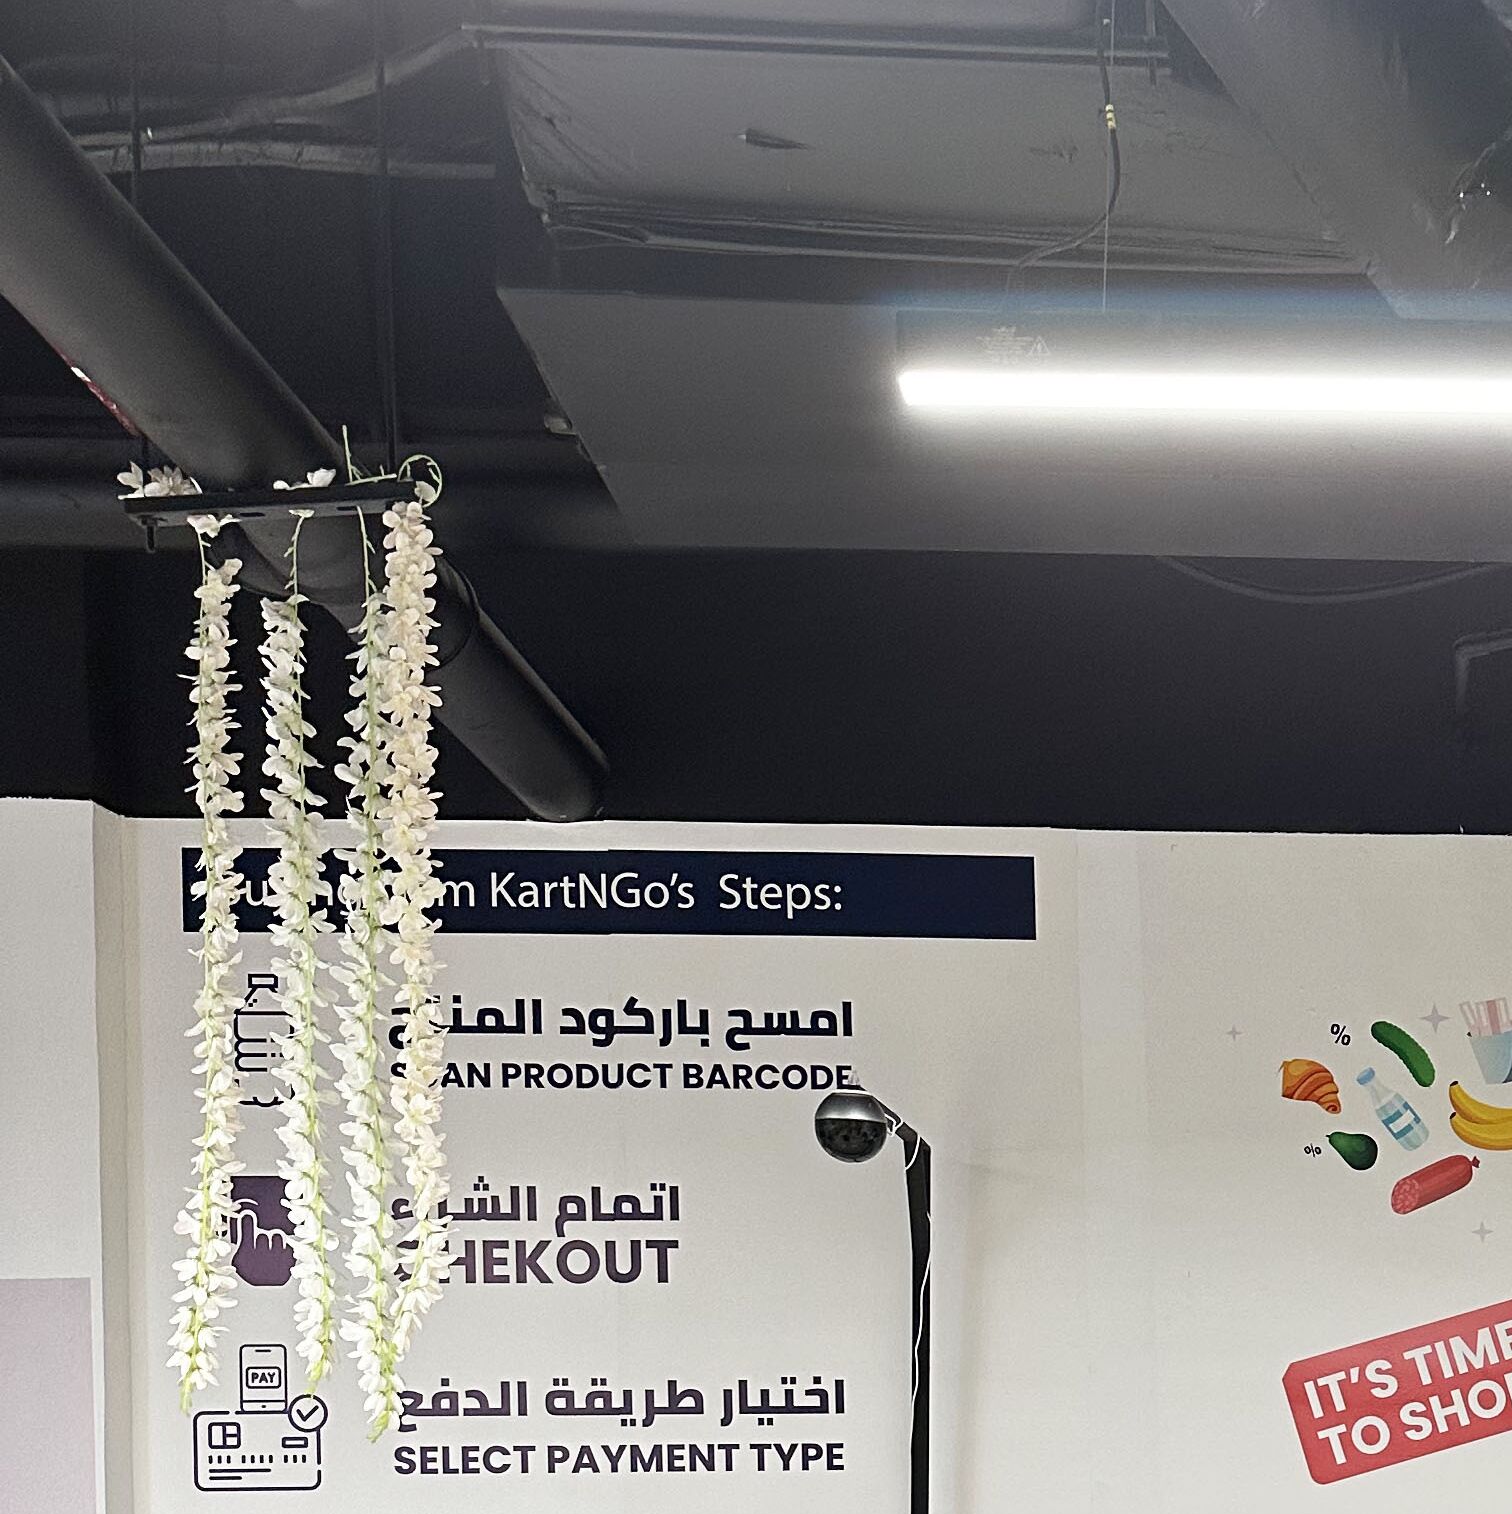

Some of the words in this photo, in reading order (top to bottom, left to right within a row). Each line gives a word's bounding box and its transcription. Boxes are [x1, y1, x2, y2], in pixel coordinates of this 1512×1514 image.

[490, 871, 697, 912] KartNGo's
[719, 875, 844, 919] Steps:
[558, 995, 711, 1049] باركود
[725, 1000, 854, 1052] امسح
[390, 1062, 492, 1090] SAN
[501, 1062, 675, 1090] PRODUCT
[682, 1063, 854, 1091] BARCODE
[390, 1175, 538, 1228] الشرء
[554, 1184, 681, 1239] اتمام
[250, 1371, 277, 1385] PAY
[544, 1377, 704, 1429] طريقة
[720, 1377, 846, 1428] اختيار
[1301, 1355, 1400, 1420] IT'S
[393, 1445, 537, 1476] SELECT
[547, 1443, 741, 1476] PAYMENT
[749, 1442, 846, 1473] TYPE
[1316, 1413, 1392, 1467] TO
